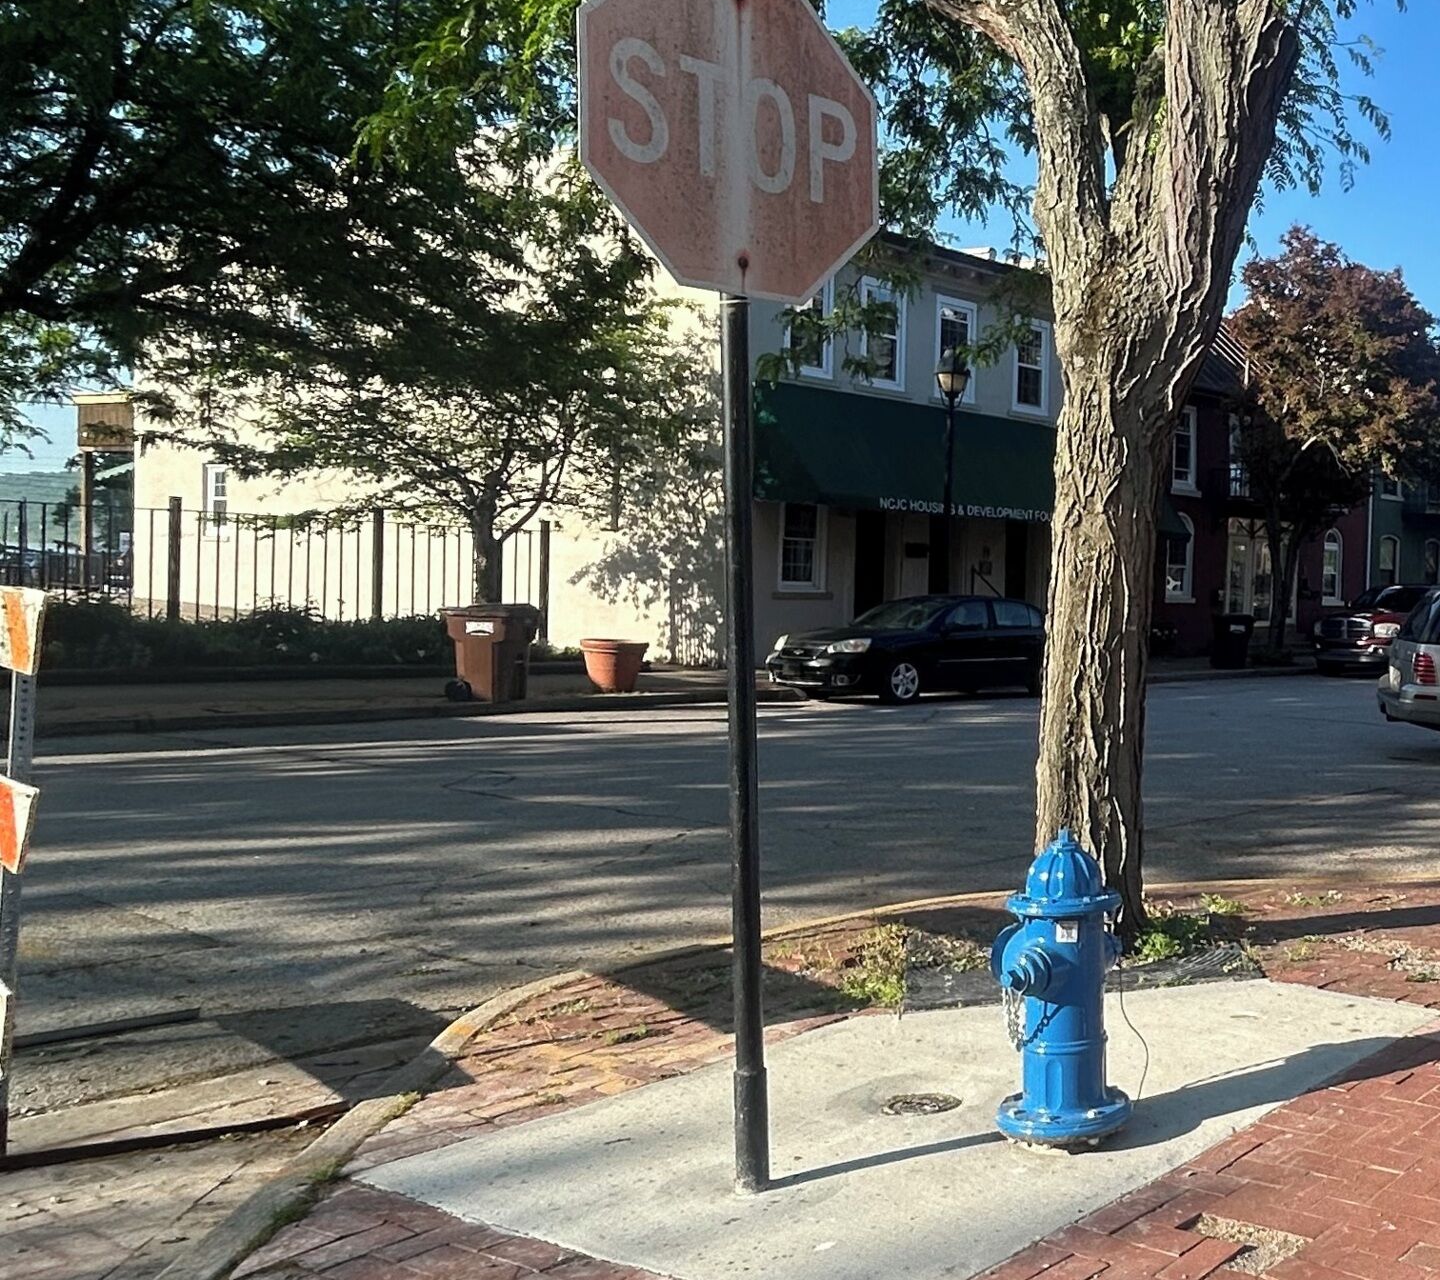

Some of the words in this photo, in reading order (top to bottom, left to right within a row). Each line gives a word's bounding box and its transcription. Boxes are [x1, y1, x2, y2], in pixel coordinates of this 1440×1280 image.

[607, 36, 858, 204] STOP
[879, 496, 908, 511] NCJC
[957, 504, 965, 516] &
[967, 505, 1033, 520] DEVELOPMENT
